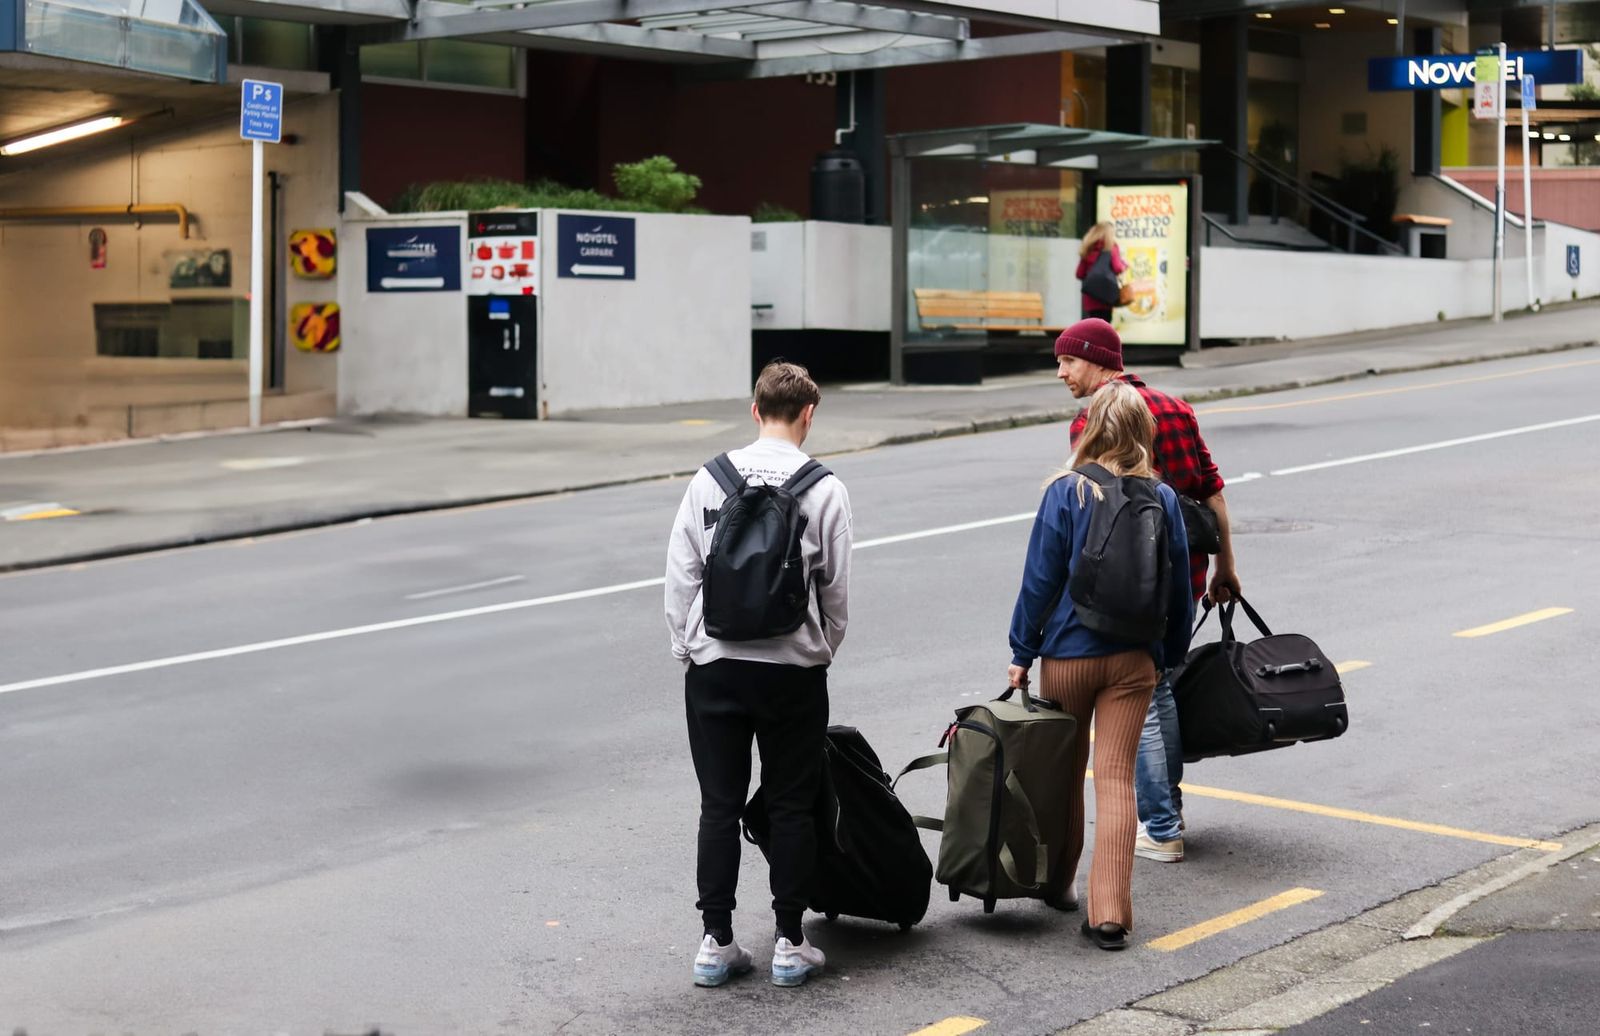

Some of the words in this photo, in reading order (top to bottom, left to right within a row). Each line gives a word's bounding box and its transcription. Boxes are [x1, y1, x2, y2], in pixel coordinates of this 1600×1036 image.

[1408, 56, 1523, 85] NOVOEL
[1115, 194, 1142, 205] NOT
[1146, 193, 1171, 204] TOO
[1111, 204, 1175, 219] GRANOLA
[1115, 218, 1140, 229] NOT
[1144, 216, 1171, 226] TOO
[576, 232, 618, 245] NOVOTEL
[1115, 227, 1167, 239] CEREAL
[580, 247, 615, 257] CARPARK
